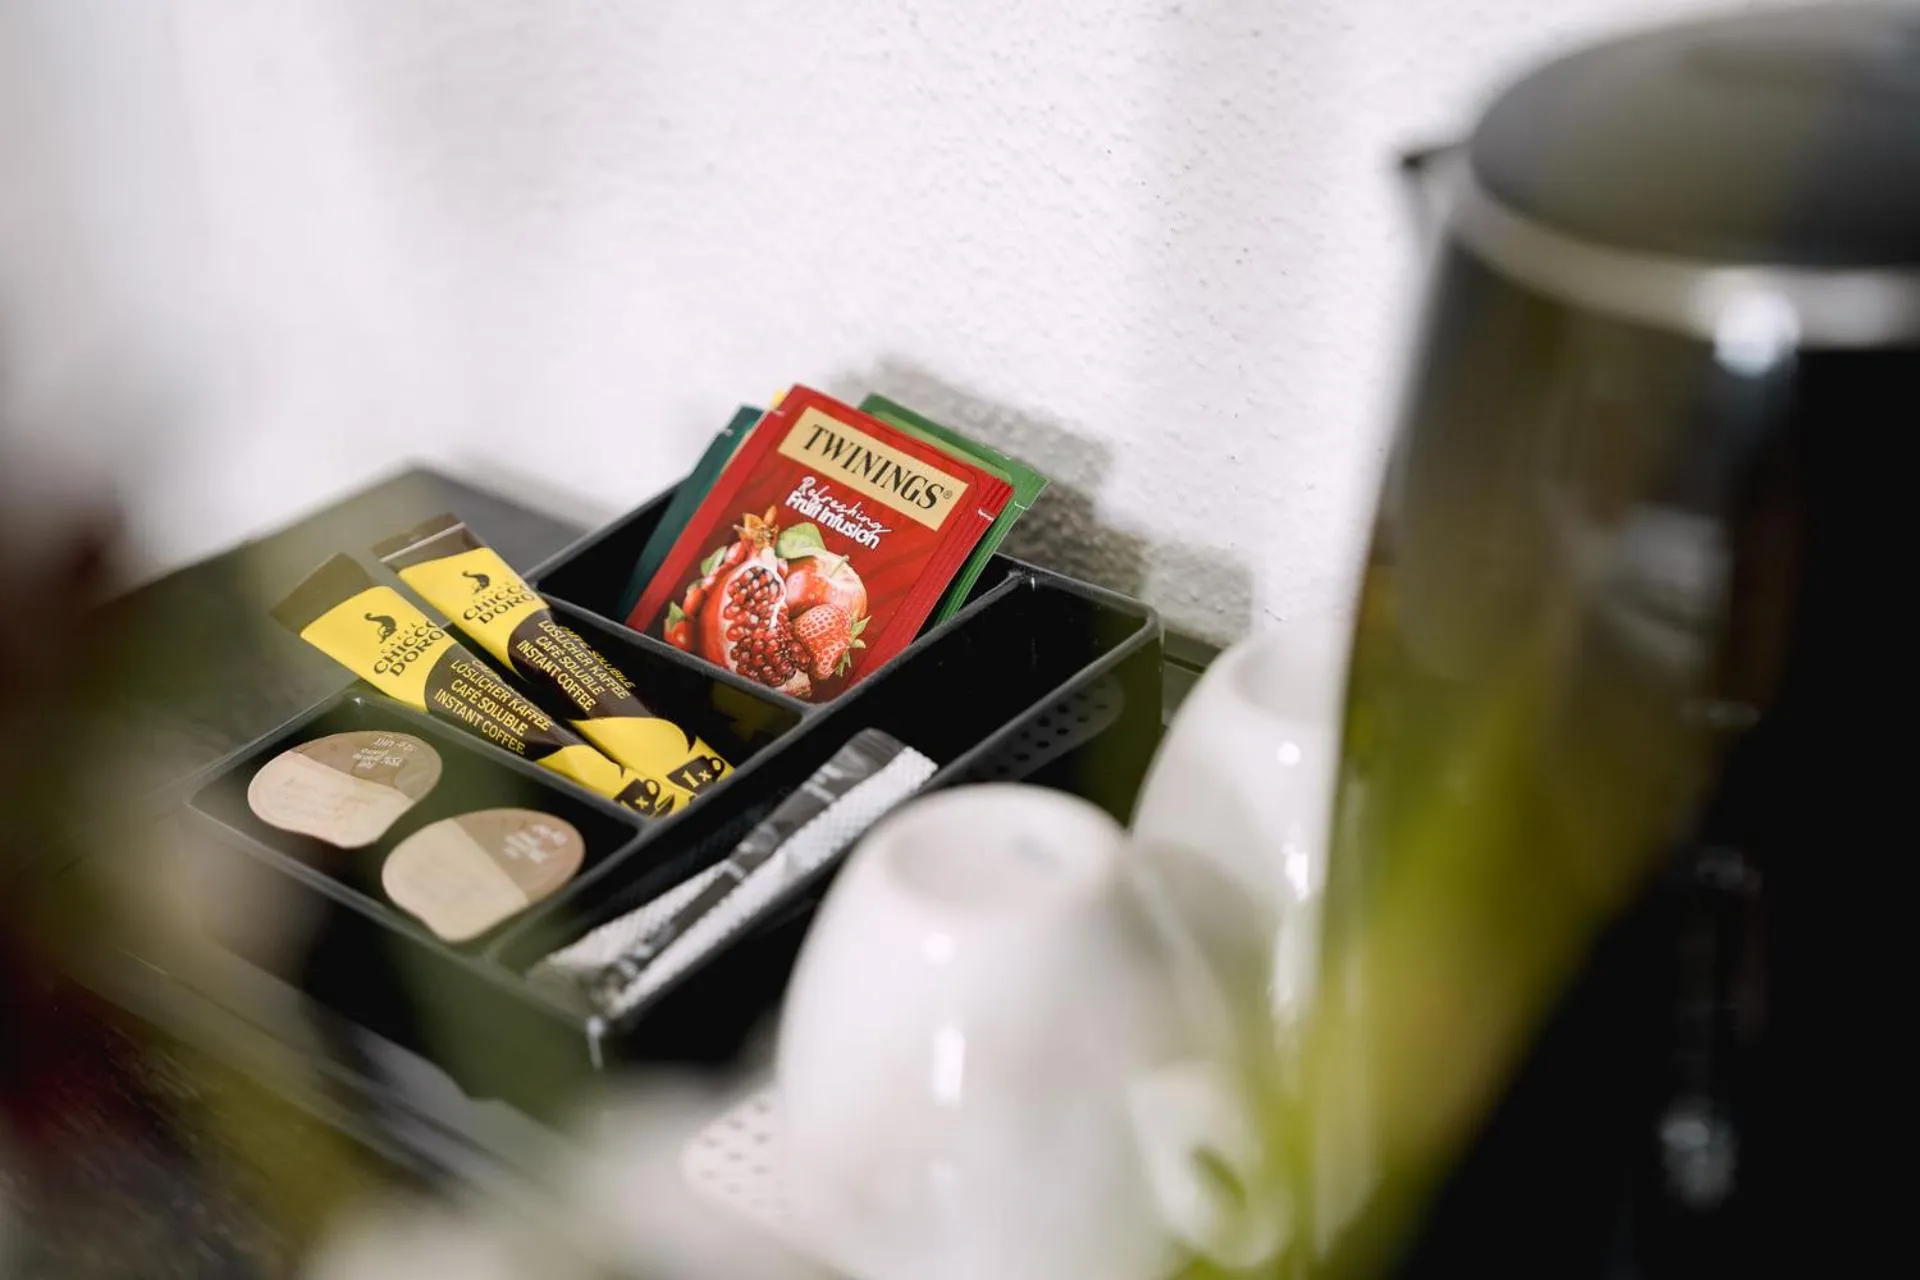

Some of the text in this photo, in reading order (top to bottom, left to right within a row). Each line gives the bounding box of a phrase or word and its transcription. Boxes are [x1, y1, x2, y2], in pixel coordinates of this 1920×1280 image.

[785, 490, 881, 550] Fruit Infusion
[797, 475, 893, 534] Refreshing
[516, 639, 562, 677] INSTANT
[557, 673, 597, 711] COFFEE
[559, 656, 605, 696] SOLUBLE
[589, 665, 631, 699] KAFFEE
[434, 688, 526, 755] INSTANT COFFEE
[477, 697, 529, 737] SOLUBLE
[507, 698, 551, 731] KAFFEE
